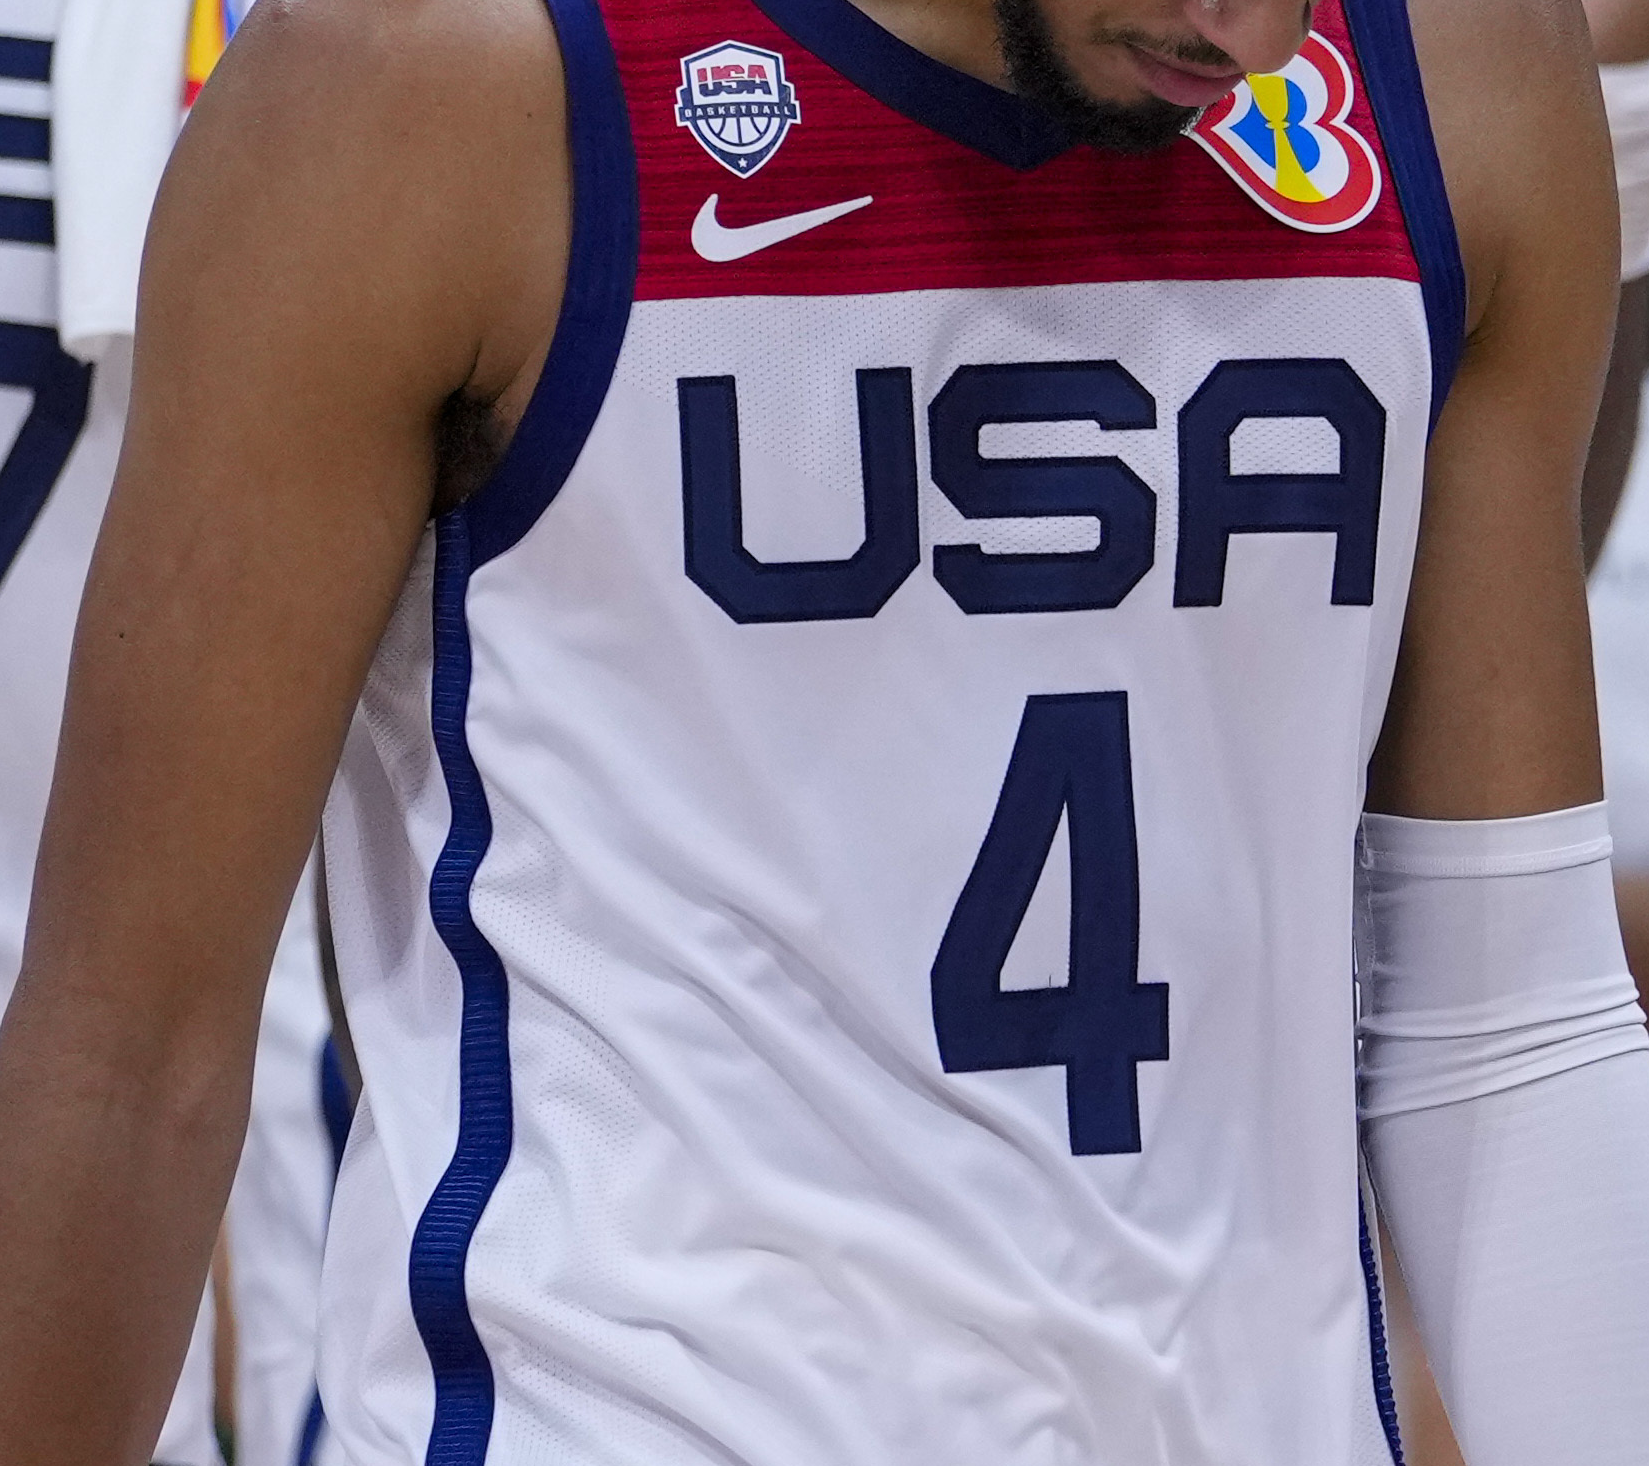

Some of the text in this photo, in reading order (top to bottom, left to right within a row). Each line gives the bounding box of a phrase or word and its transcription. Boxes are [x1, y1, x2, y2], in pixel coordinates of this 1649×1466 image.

[684, 105, 791, 118] BASKETBALL
[696, 64, 773, 98] USA
[676, 358, 1386, 624] USA
[930, 690, 1170, 1156] 4
